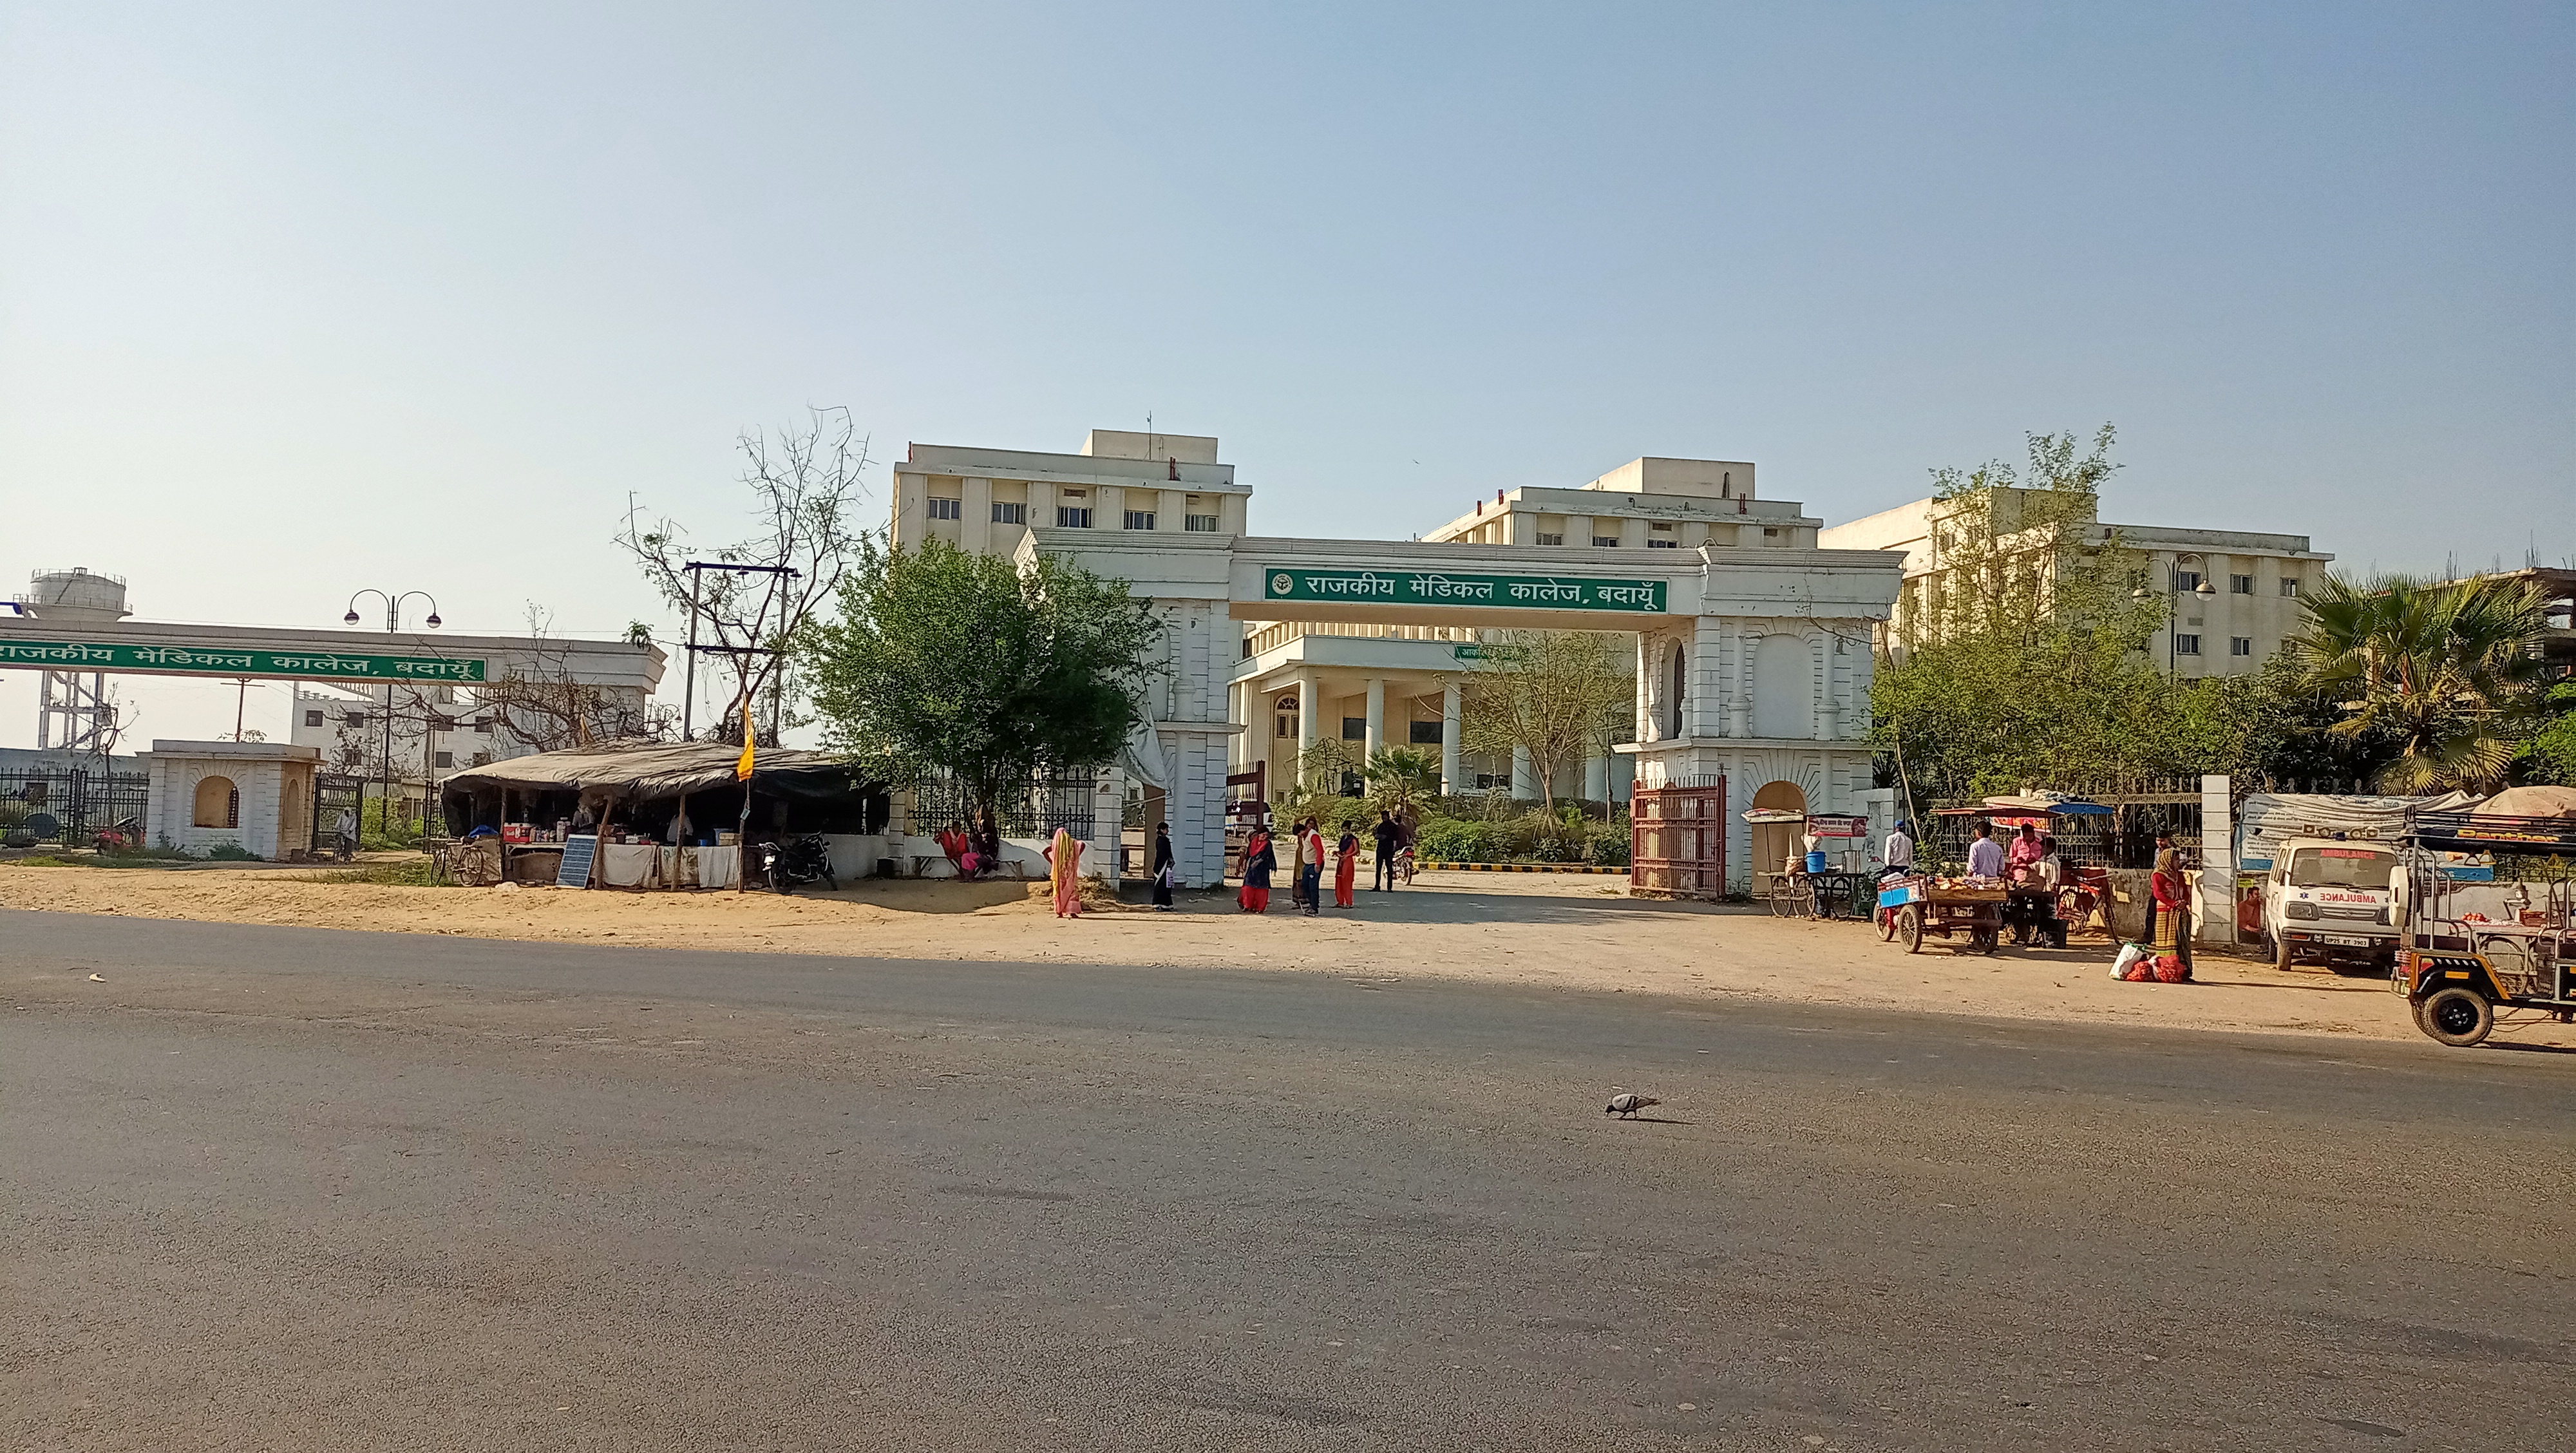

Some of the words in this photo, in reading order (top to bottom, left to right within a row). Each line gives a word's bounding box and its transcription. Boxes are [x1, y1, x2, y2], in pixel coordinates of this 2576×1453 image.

[1305, 572, 1396, 596] राजकीय
[1408, 574, 1494, 599] मेडिकल
[1508, 578, 1590, 604] कालेज,
[1596, 582, 1658, 611] बदायूँ
[132, 647, 254, 667] मेडिकल
[270, 654, 380, 675] कालेज,
[2321, 850, 2376, 859] AMBULANCE
